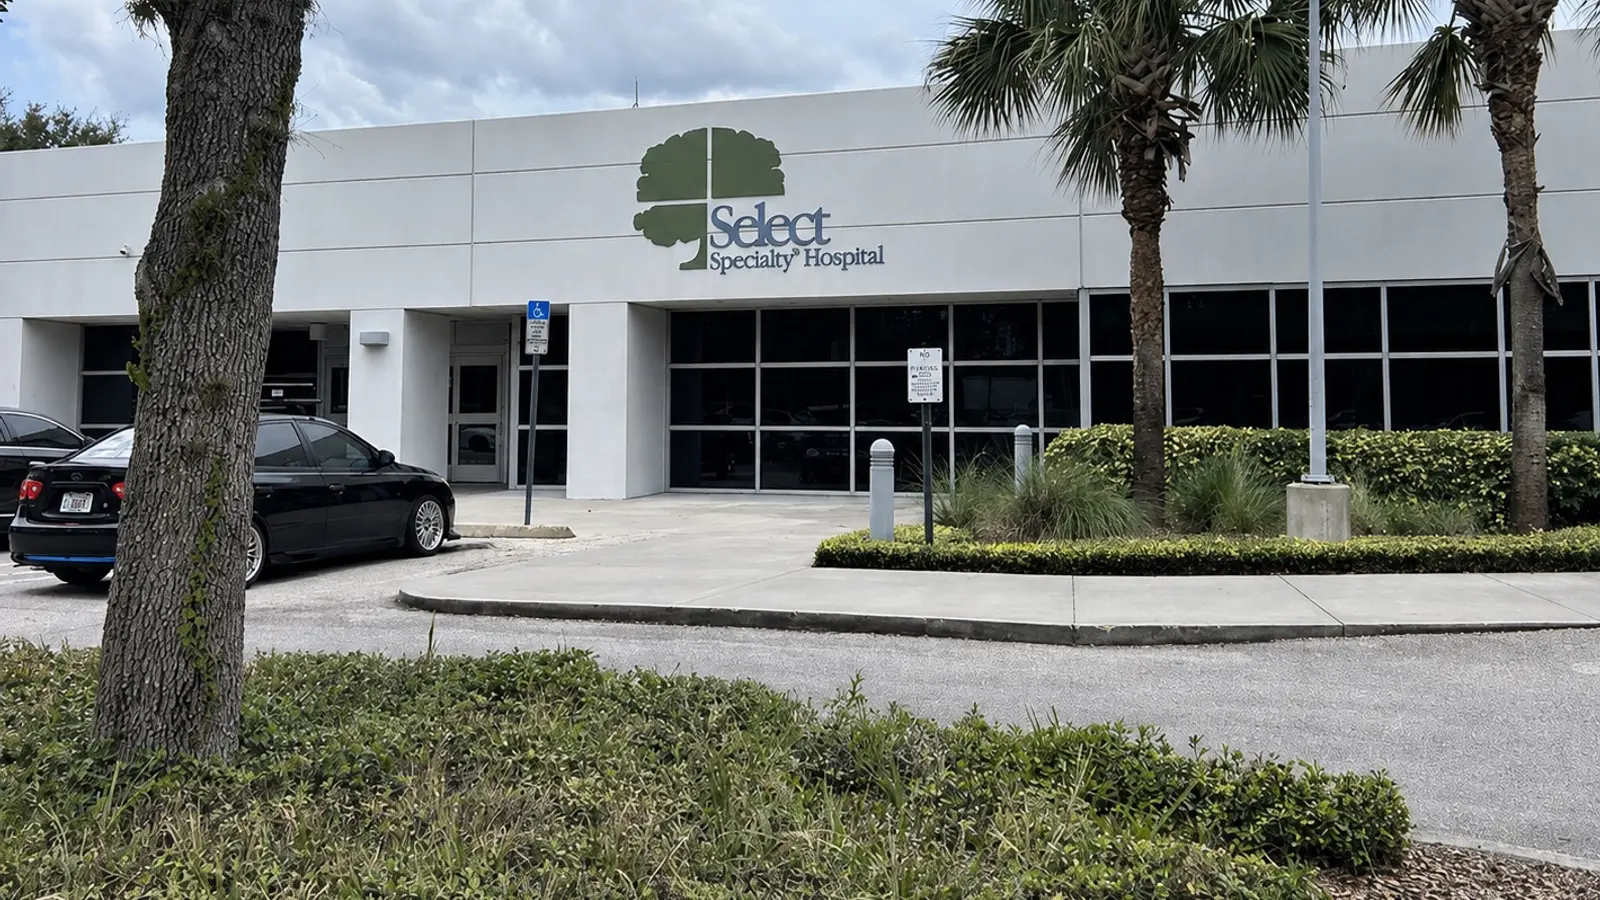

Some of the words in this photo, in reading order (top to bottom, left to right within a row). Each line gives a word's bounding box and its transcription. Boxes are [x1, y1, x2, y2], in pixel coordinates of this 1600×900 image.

[710, 201, 831, 249] Select
[710, 249, 794, 275] Specialty
[803, 245, 885, 271] Hospital
